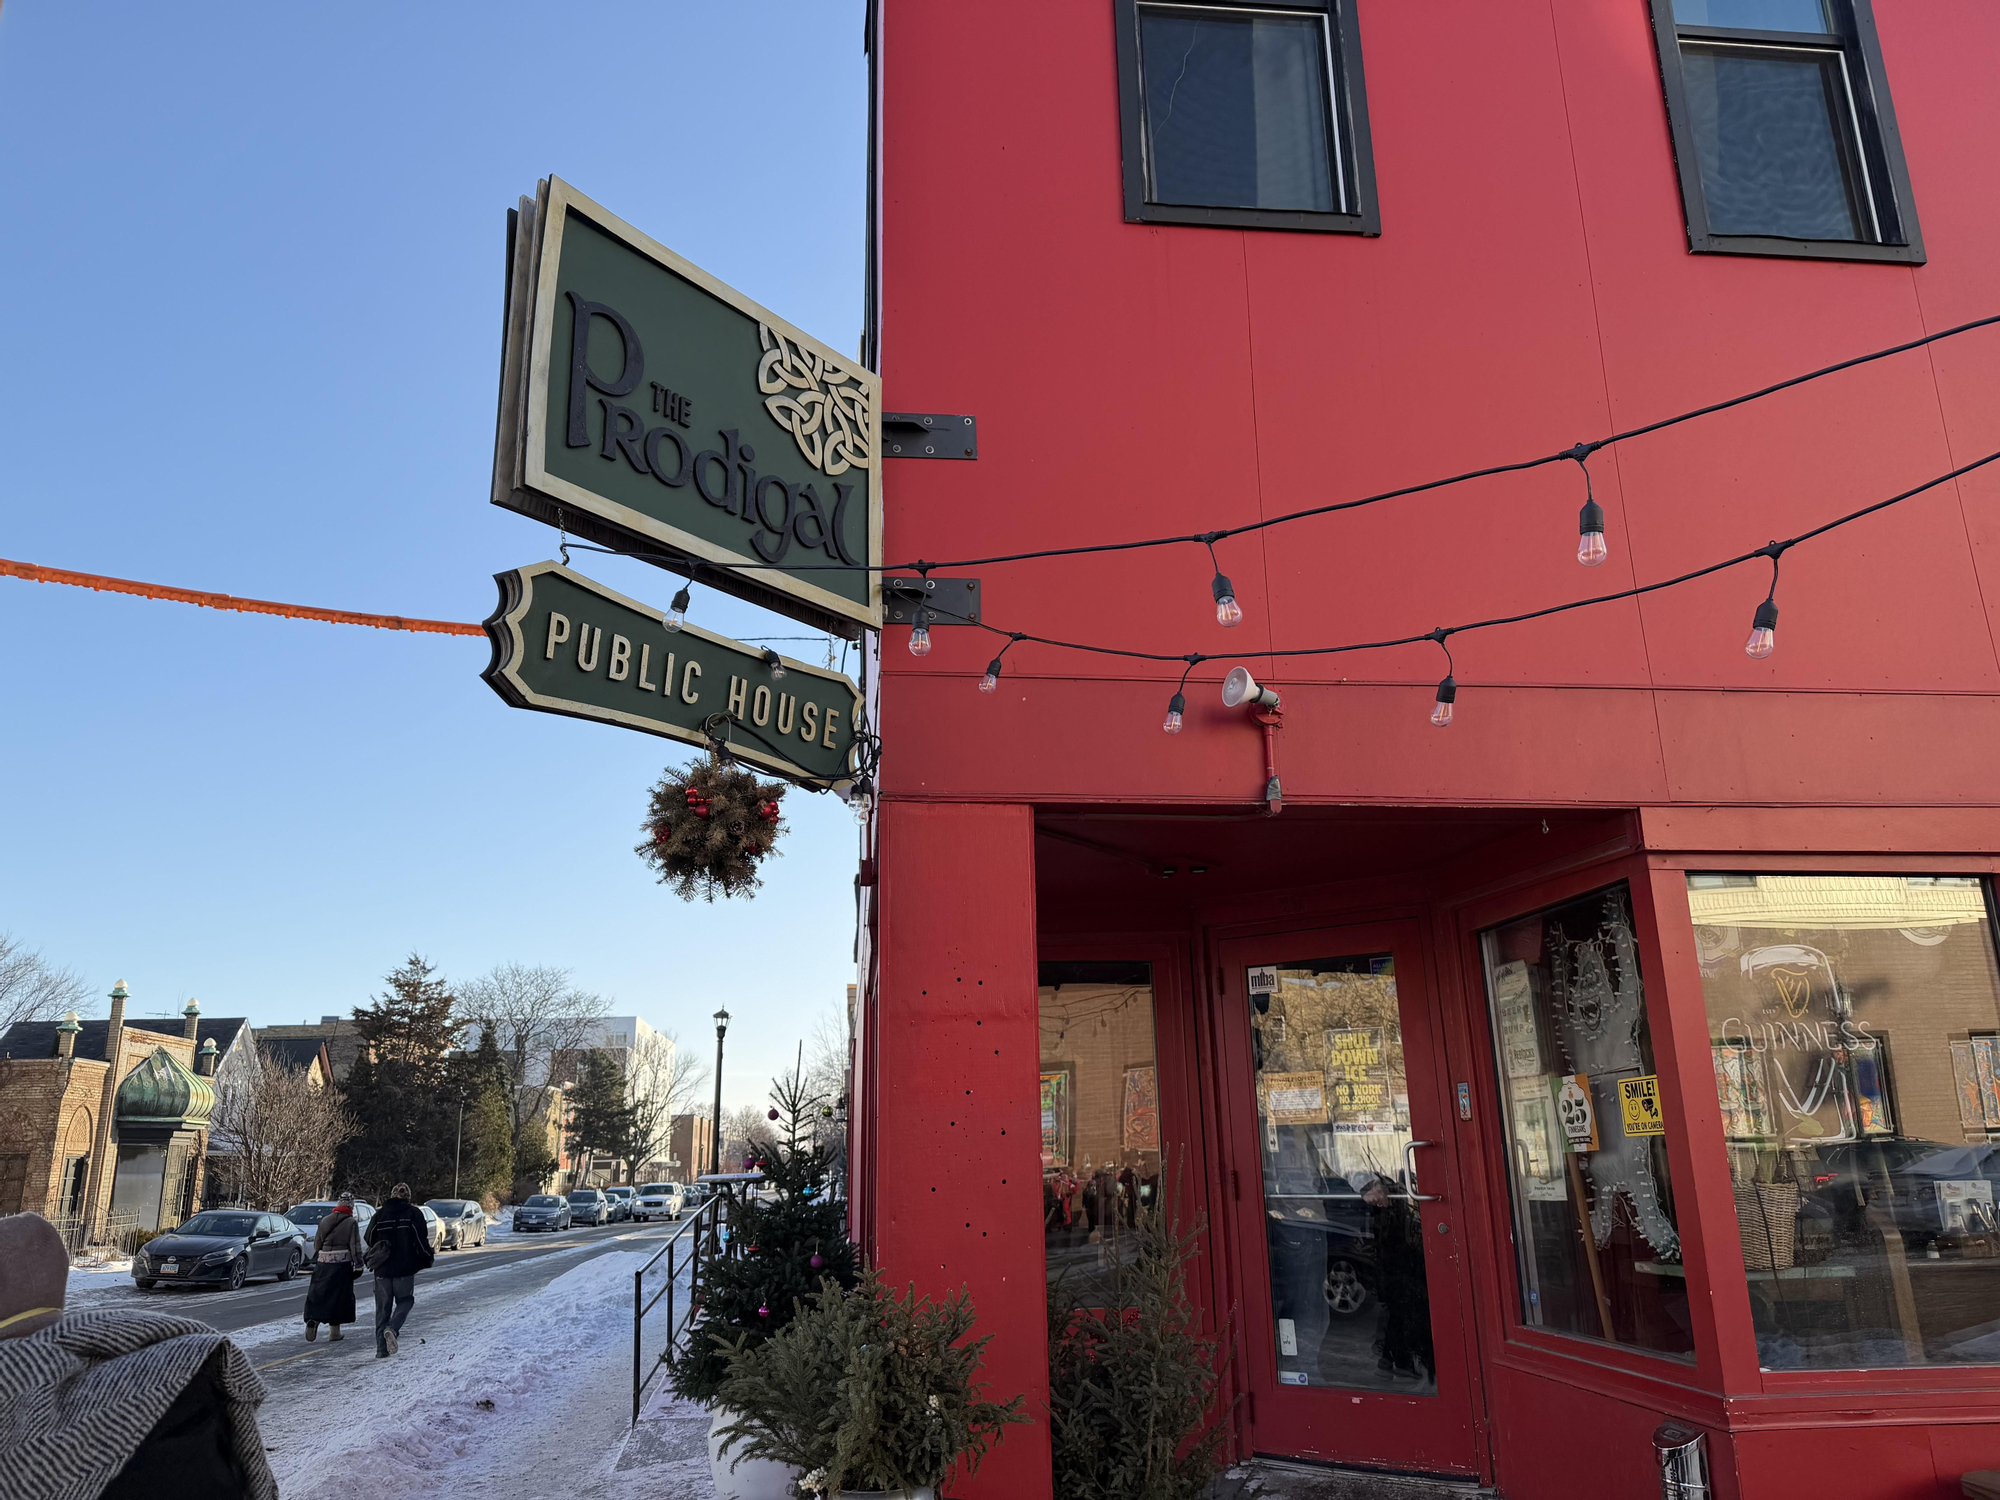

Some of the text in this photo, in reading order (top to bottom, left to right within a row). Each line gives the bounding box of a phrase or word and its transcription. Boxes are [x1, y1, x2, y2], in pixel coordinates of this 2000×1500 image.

[651, 380, 692, 428] THE
[545, 611, 841, 750] PUBLIC HOUSE
[1502, 1005, 1522, 1017] BEER
[1503, 1024, 1524, 1036] BUMP
[1722, 1018, 1876, 1053] GUINNESS
[1334, 1032, 1371, 1049] SHUT
[1331, 1048, 1379, 1066] DOWN
[1344, 1065, 1367, 1082] ICE
[1336, 1084, 1382, 1096] NO WORK
[1624, 1080, 1656, 1100] SMILE!
[1339, 1094, 1381, 1104] NO SCHOOL
[1562, 1097, 1587, 1125] 25
[1627, 1122, 1641, 1131] YOU'RE
[1641, 1121, 1648, 1130] ON
